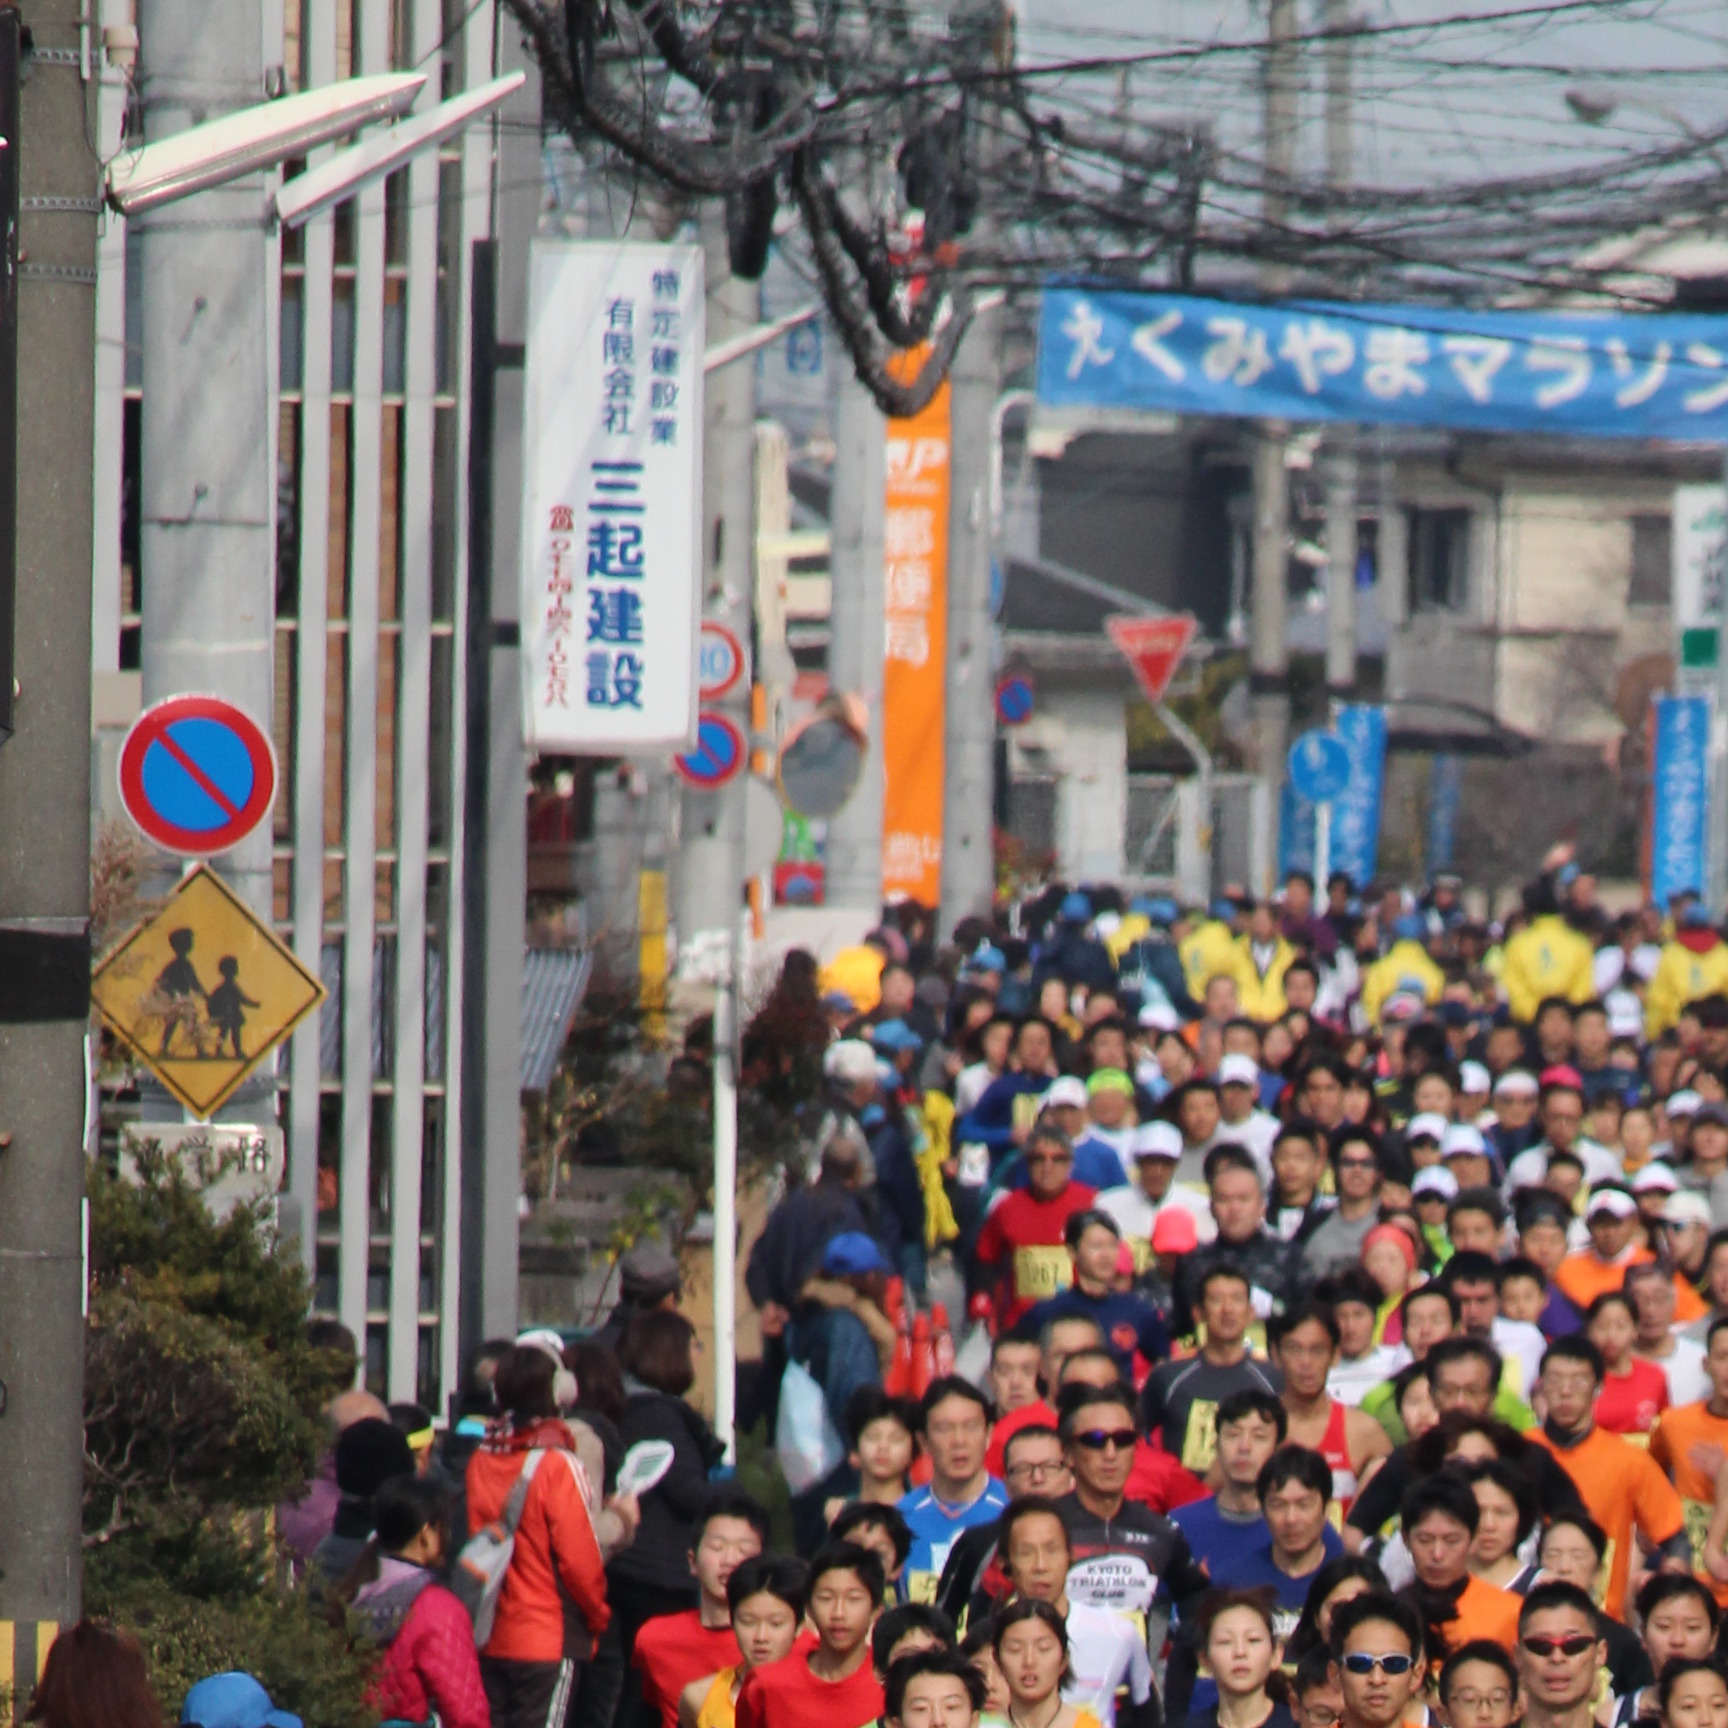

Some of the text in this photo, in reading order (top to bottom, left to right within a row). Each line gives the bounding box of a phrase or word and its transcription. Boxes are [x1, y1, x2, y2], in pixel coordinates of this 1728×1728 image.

[603, 296, 636, 437] 有限会社
[650, 269, 680, 447] 特定建設業
[584, 460, 647, 711] 三起建設
